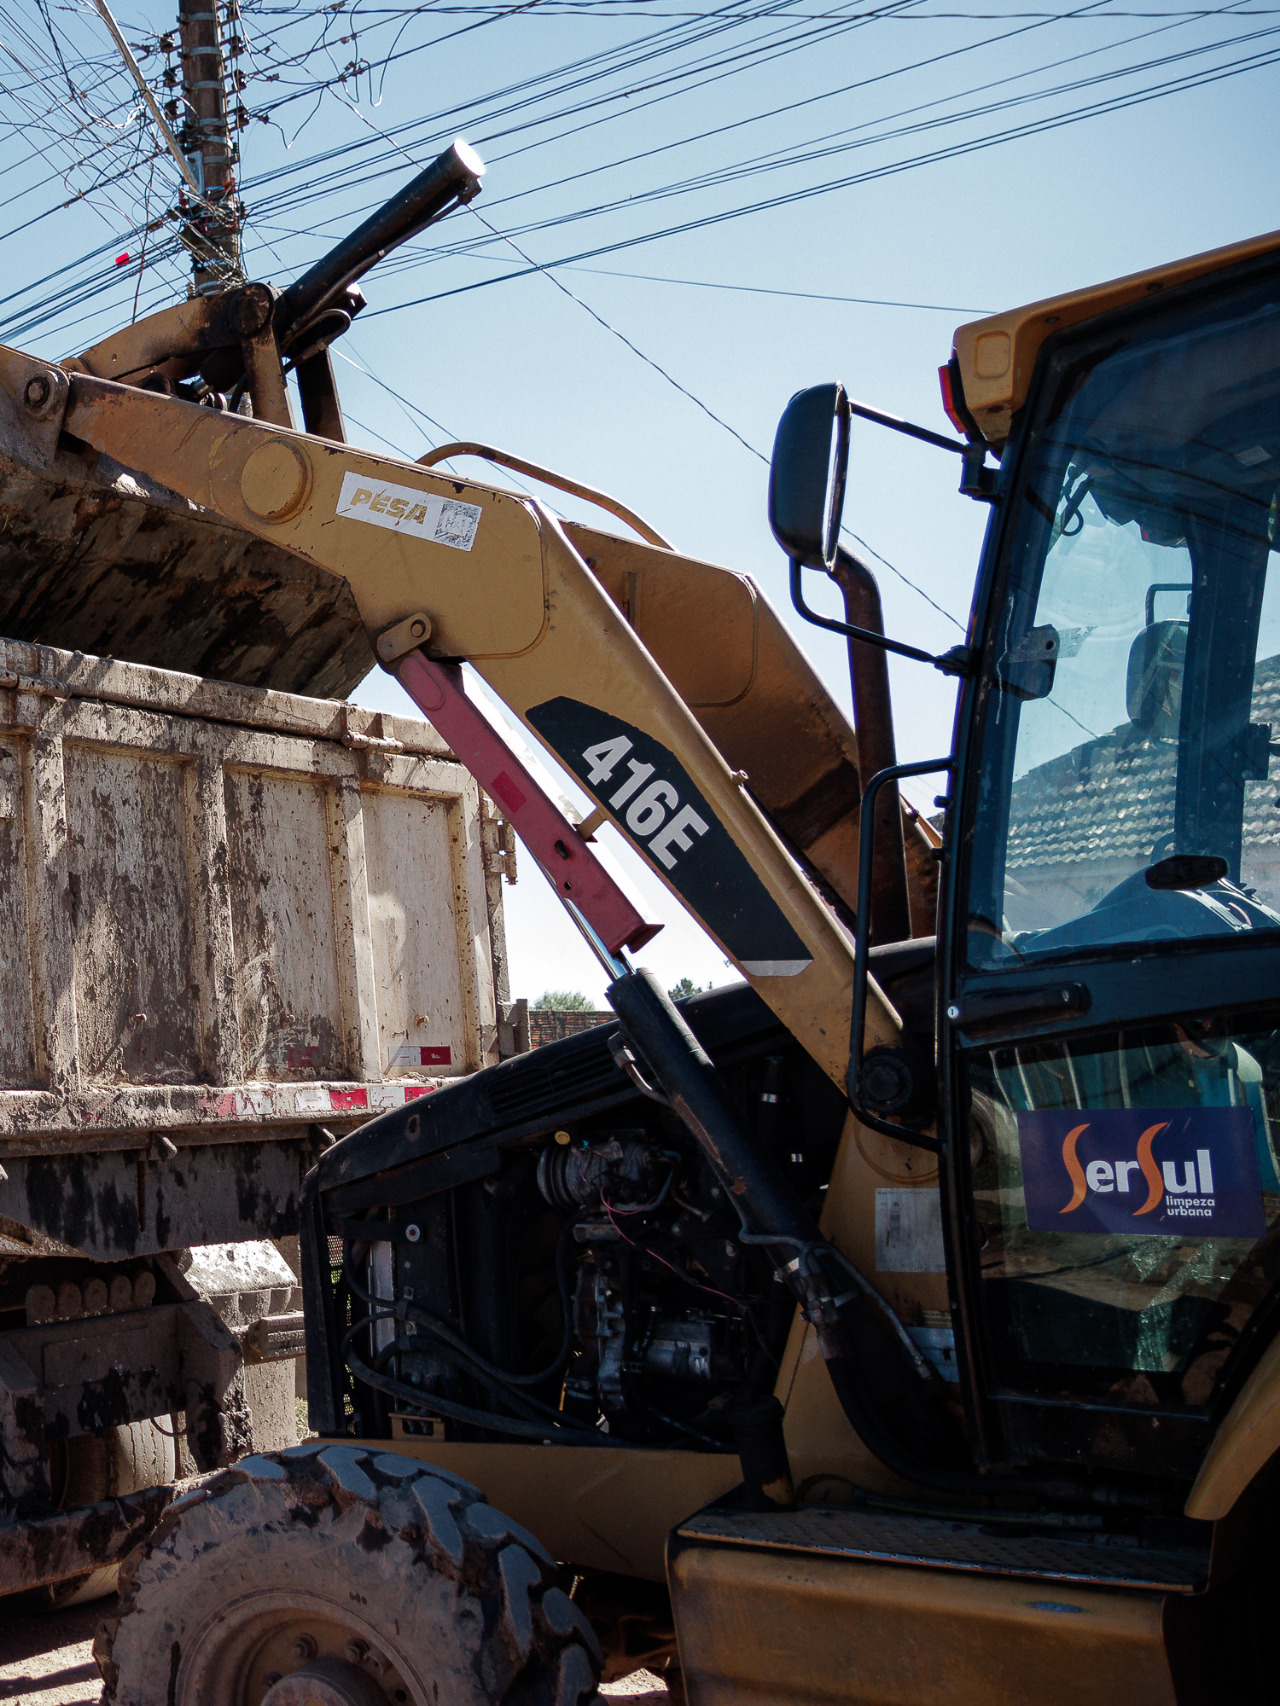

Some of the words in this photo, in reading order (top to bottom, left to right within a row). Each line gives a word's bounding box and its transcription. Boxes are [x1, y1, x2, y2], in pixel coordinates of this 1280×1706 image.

[350, 487, 428, 525] PESA
[582, 735, 710, 870] 416E
[1058, 1122, 1214, 1216] SerSul
[1165, 1196, 1215, 1211] limpeza
[1166, 1206, 1213, 1217] urbana
